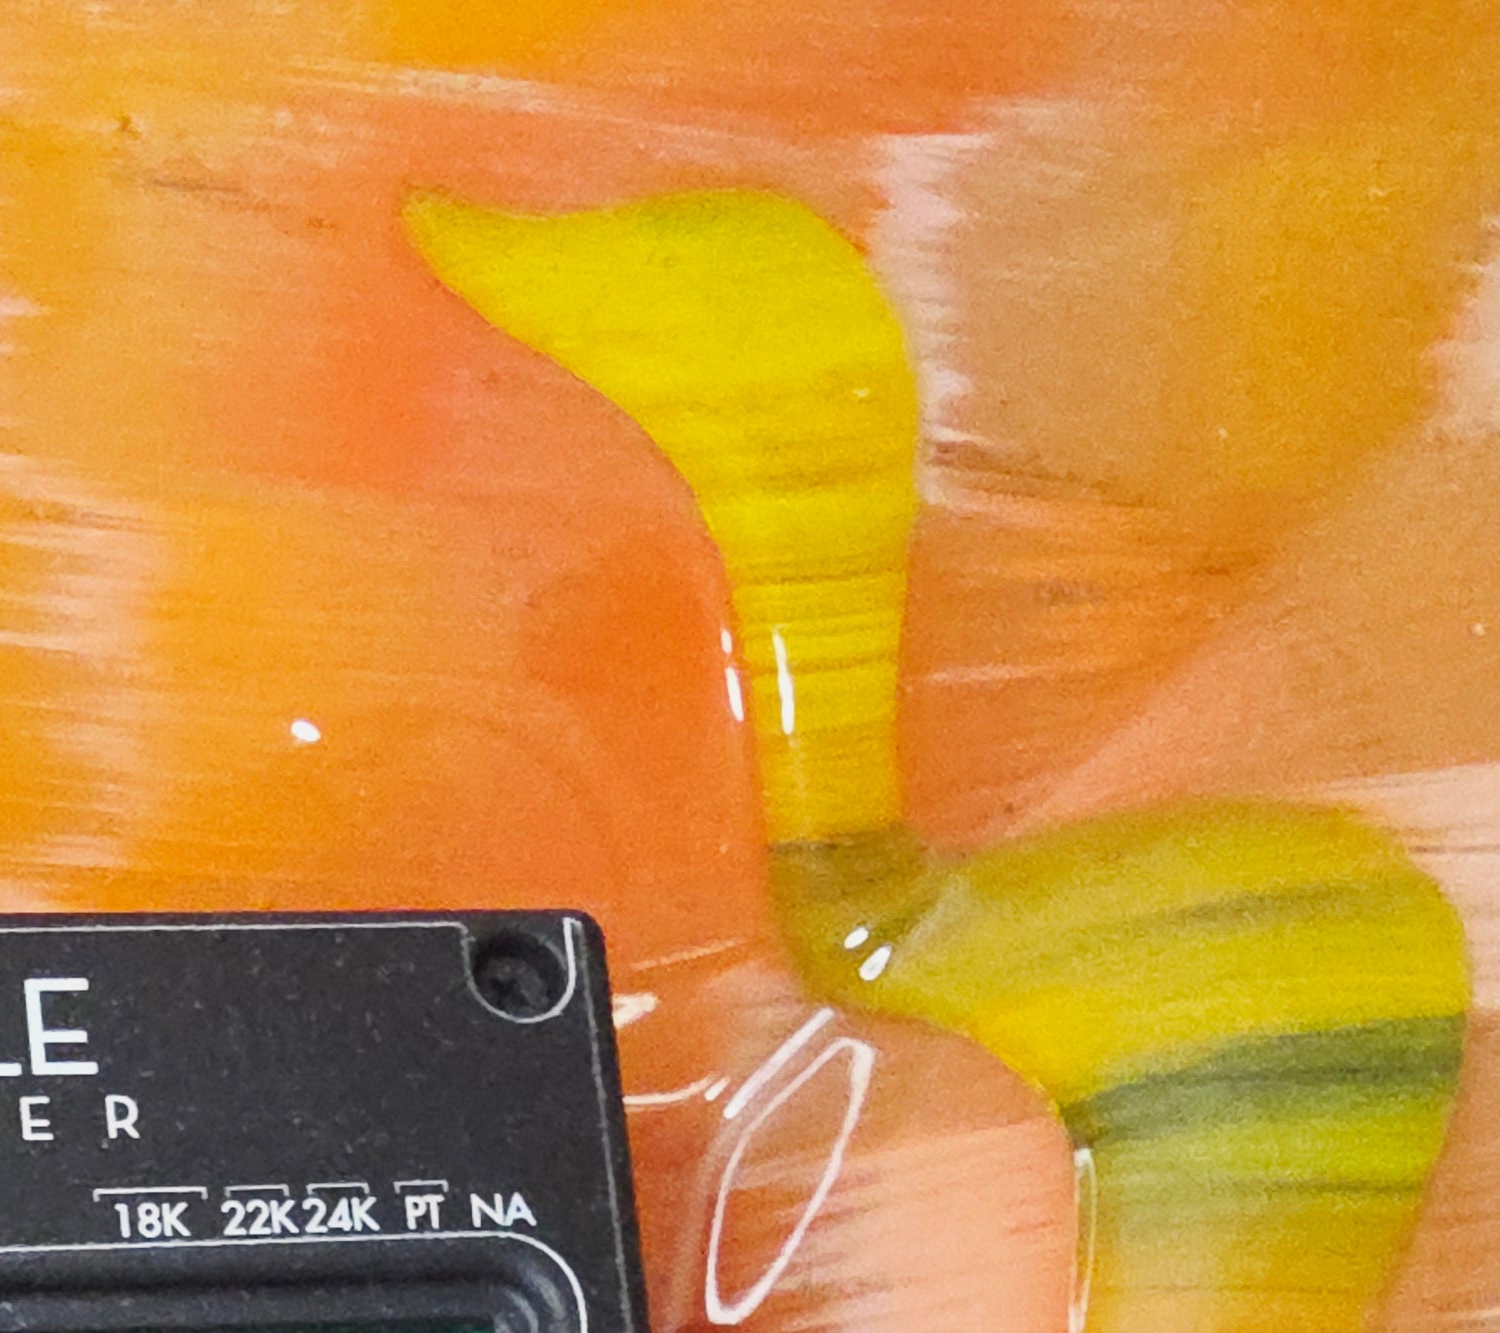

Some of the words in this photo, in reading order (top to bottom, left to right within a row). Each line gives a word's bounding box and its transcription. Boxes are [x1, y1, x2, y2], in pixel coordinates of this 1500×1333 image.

[113, 1201, 192, 1238] 18K
[220, 1199, 300, 1237] 22K
[304, 1197, 380, 1234] 24K
[405, 1194, 445, 1231] PT
[470, 1192, 537, 1228] NA
